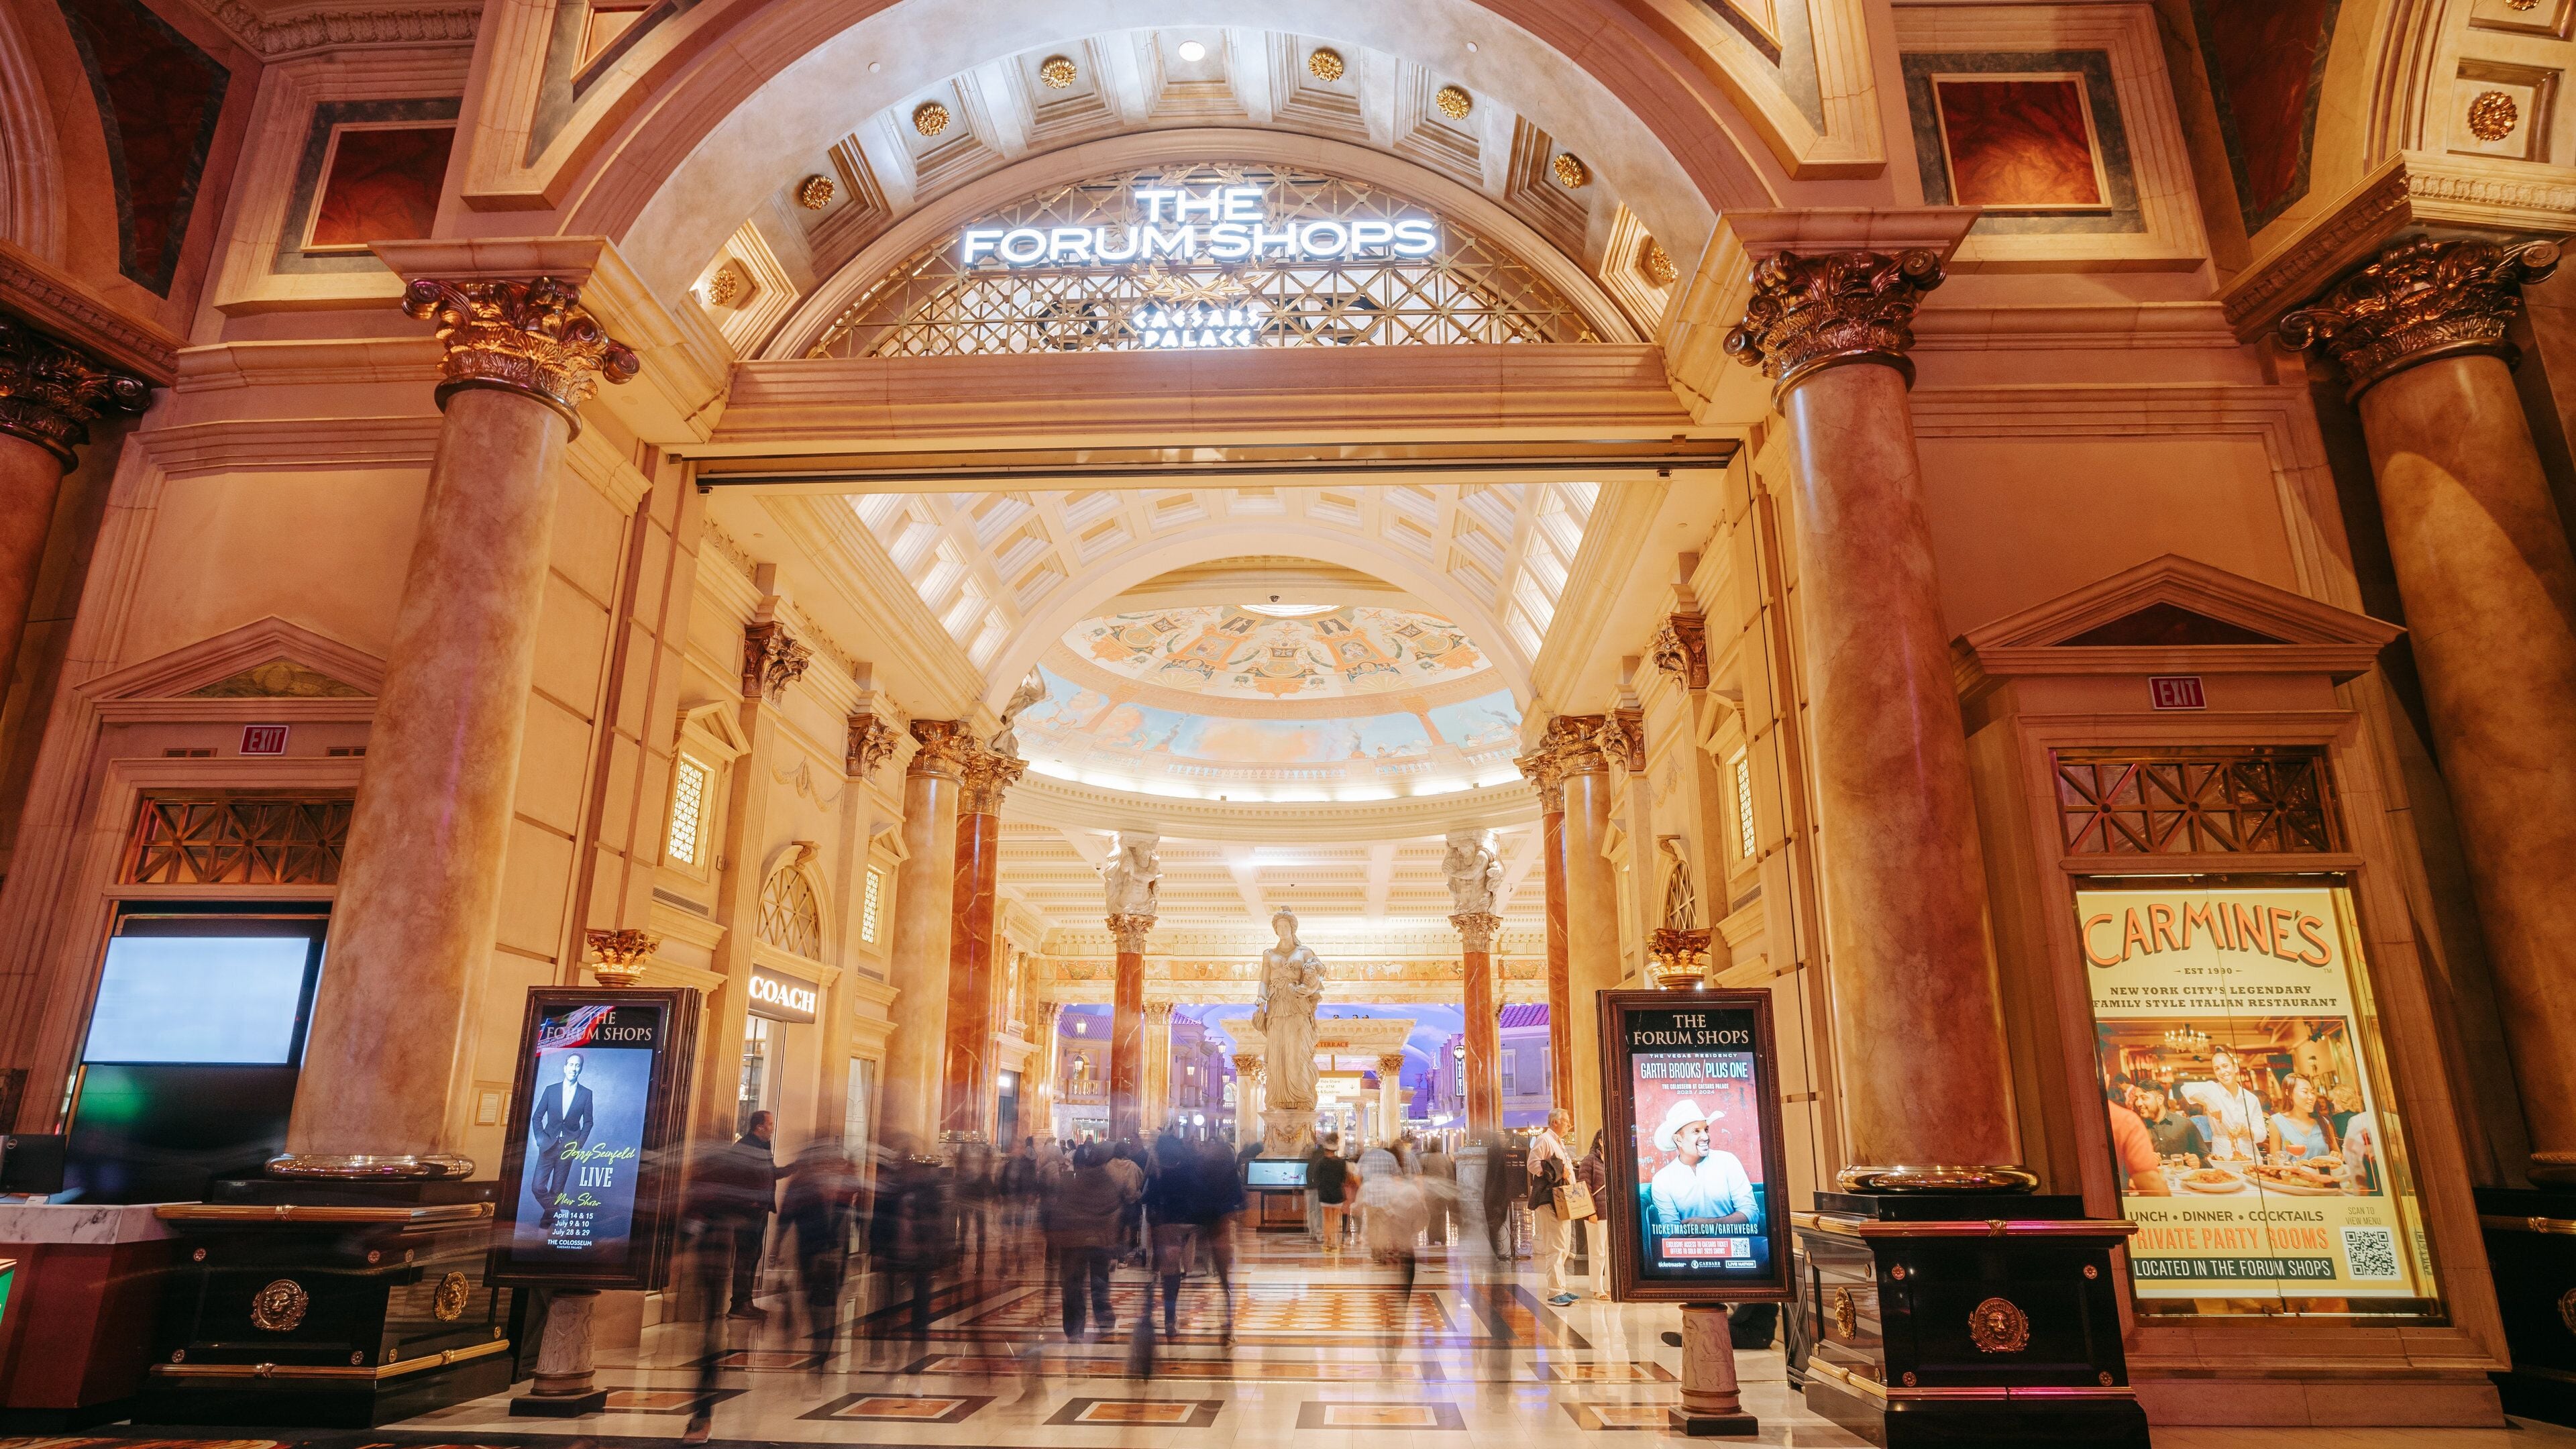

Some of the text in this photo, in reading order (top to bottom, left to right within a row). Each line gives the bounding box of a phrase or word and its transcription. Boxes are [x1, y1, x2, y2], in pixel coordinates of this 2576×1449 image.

[1134, 188, 1263, 223] THE
[963, 219, 1437, 264] FORUM SHOPS
[1132, 309, 1260, 329] CAESARS
[1144, 328, 1251, 348] PALACE
[2158, 680, 2197, 706] EXIT
[247, 728, 283, 751] EXIT
[2083, 900, 2332, 968] CARMINE'S
[749, 975, 816, 1014] COACH
[2110, 985, 2312, 995] NEW YORK CITY'S LEGENDARY
[2093, 998, 2337, 1008] FAMILY STYLE ITALIAN RESTAURANT
[1672, 1014, 1707, 1028] THE
[604, 1027, 653, 1040] SHOPS
[1633, 1030, 1750, 1045] FORUM SHOPS
[1640, 1062, 1748, 1079] GARTH BROOKS PLUS ONE
[560, 1141, 636, 1165] Jerry Seinfeld
[579, 1167, 613, 1187] LIVE
[554, 1192, 601, 1207] New Show
[553, 1212, 569, 1220] April
[2129, 1210, 2324, 1222] UNCH DINNER COCKTAILS
[2348, 1206, 2375, 1215] SCAN TO
[555, 1220, 568, 1228] July
[2345, 1216, 2381, 1225] VIEW MENU
[552, 1228, 566, 1237] July
[1652, 1223, 1758, 1236] TICKETMASTER.COM/GARTHVEGAS
[2129, 1226, 2330, 1250] RIVATE PARTY ROOMS
[2133, 1259, 2331, 1276] LOCATED IN THE FORUM SHOPS
